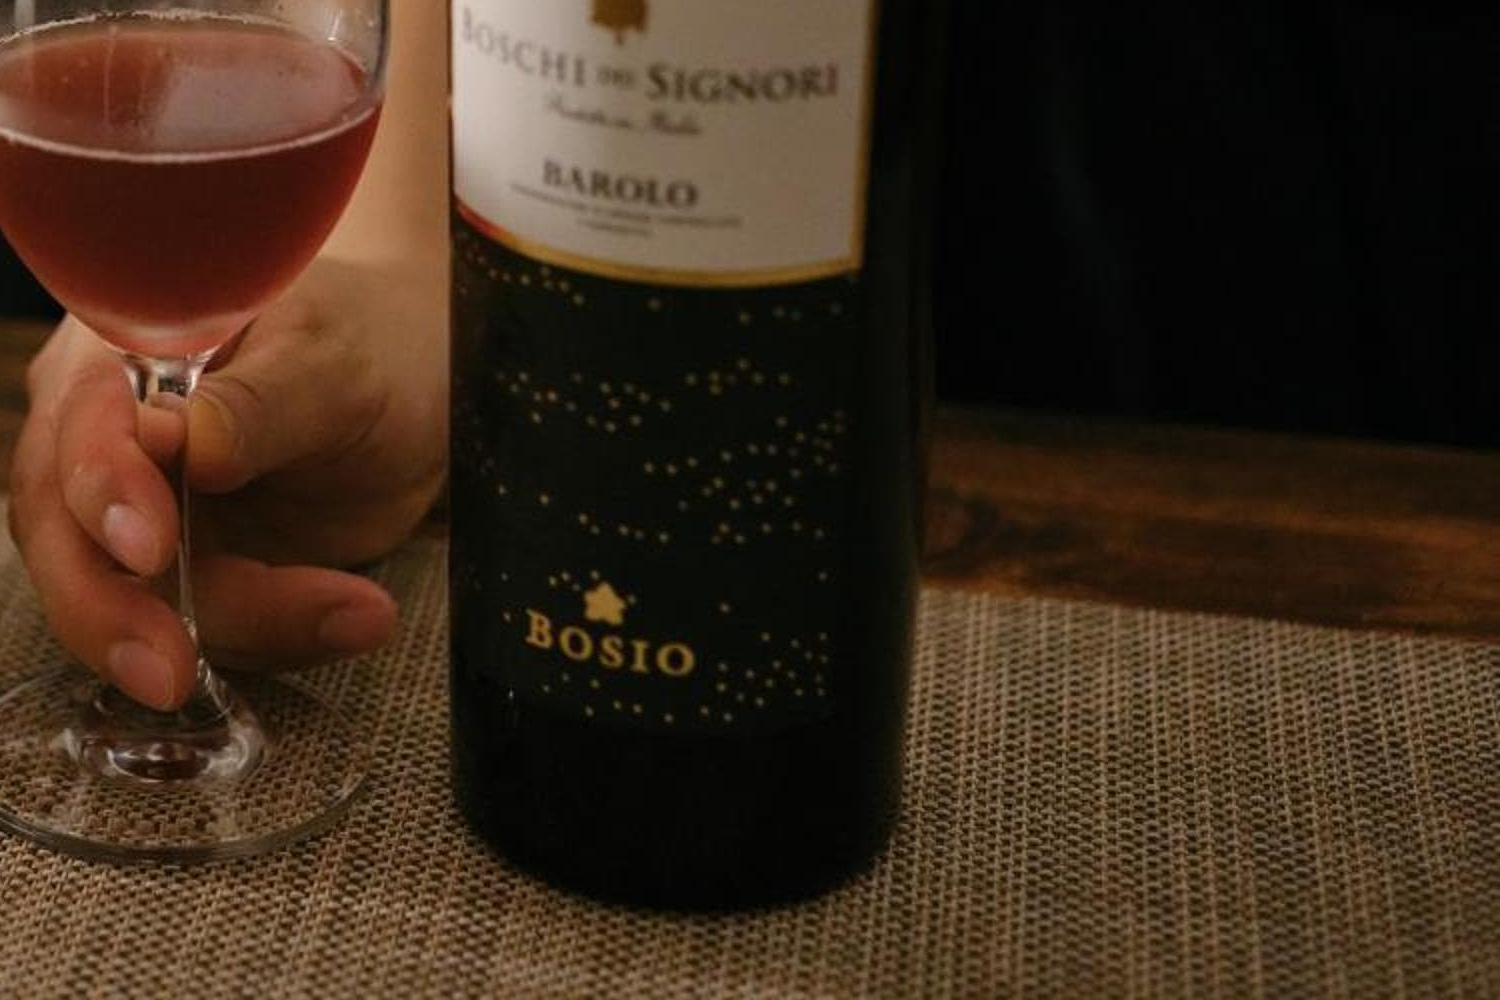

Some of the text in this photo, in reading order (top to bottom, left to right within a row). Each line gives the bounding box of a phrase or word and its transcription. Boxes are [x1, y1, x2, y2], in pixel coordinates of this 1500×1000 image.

[646, 61, 838, 103] SIGNORI
[543, 159, 700, 208] BAROLO
[525, 608, 696, 678] BOSIO
